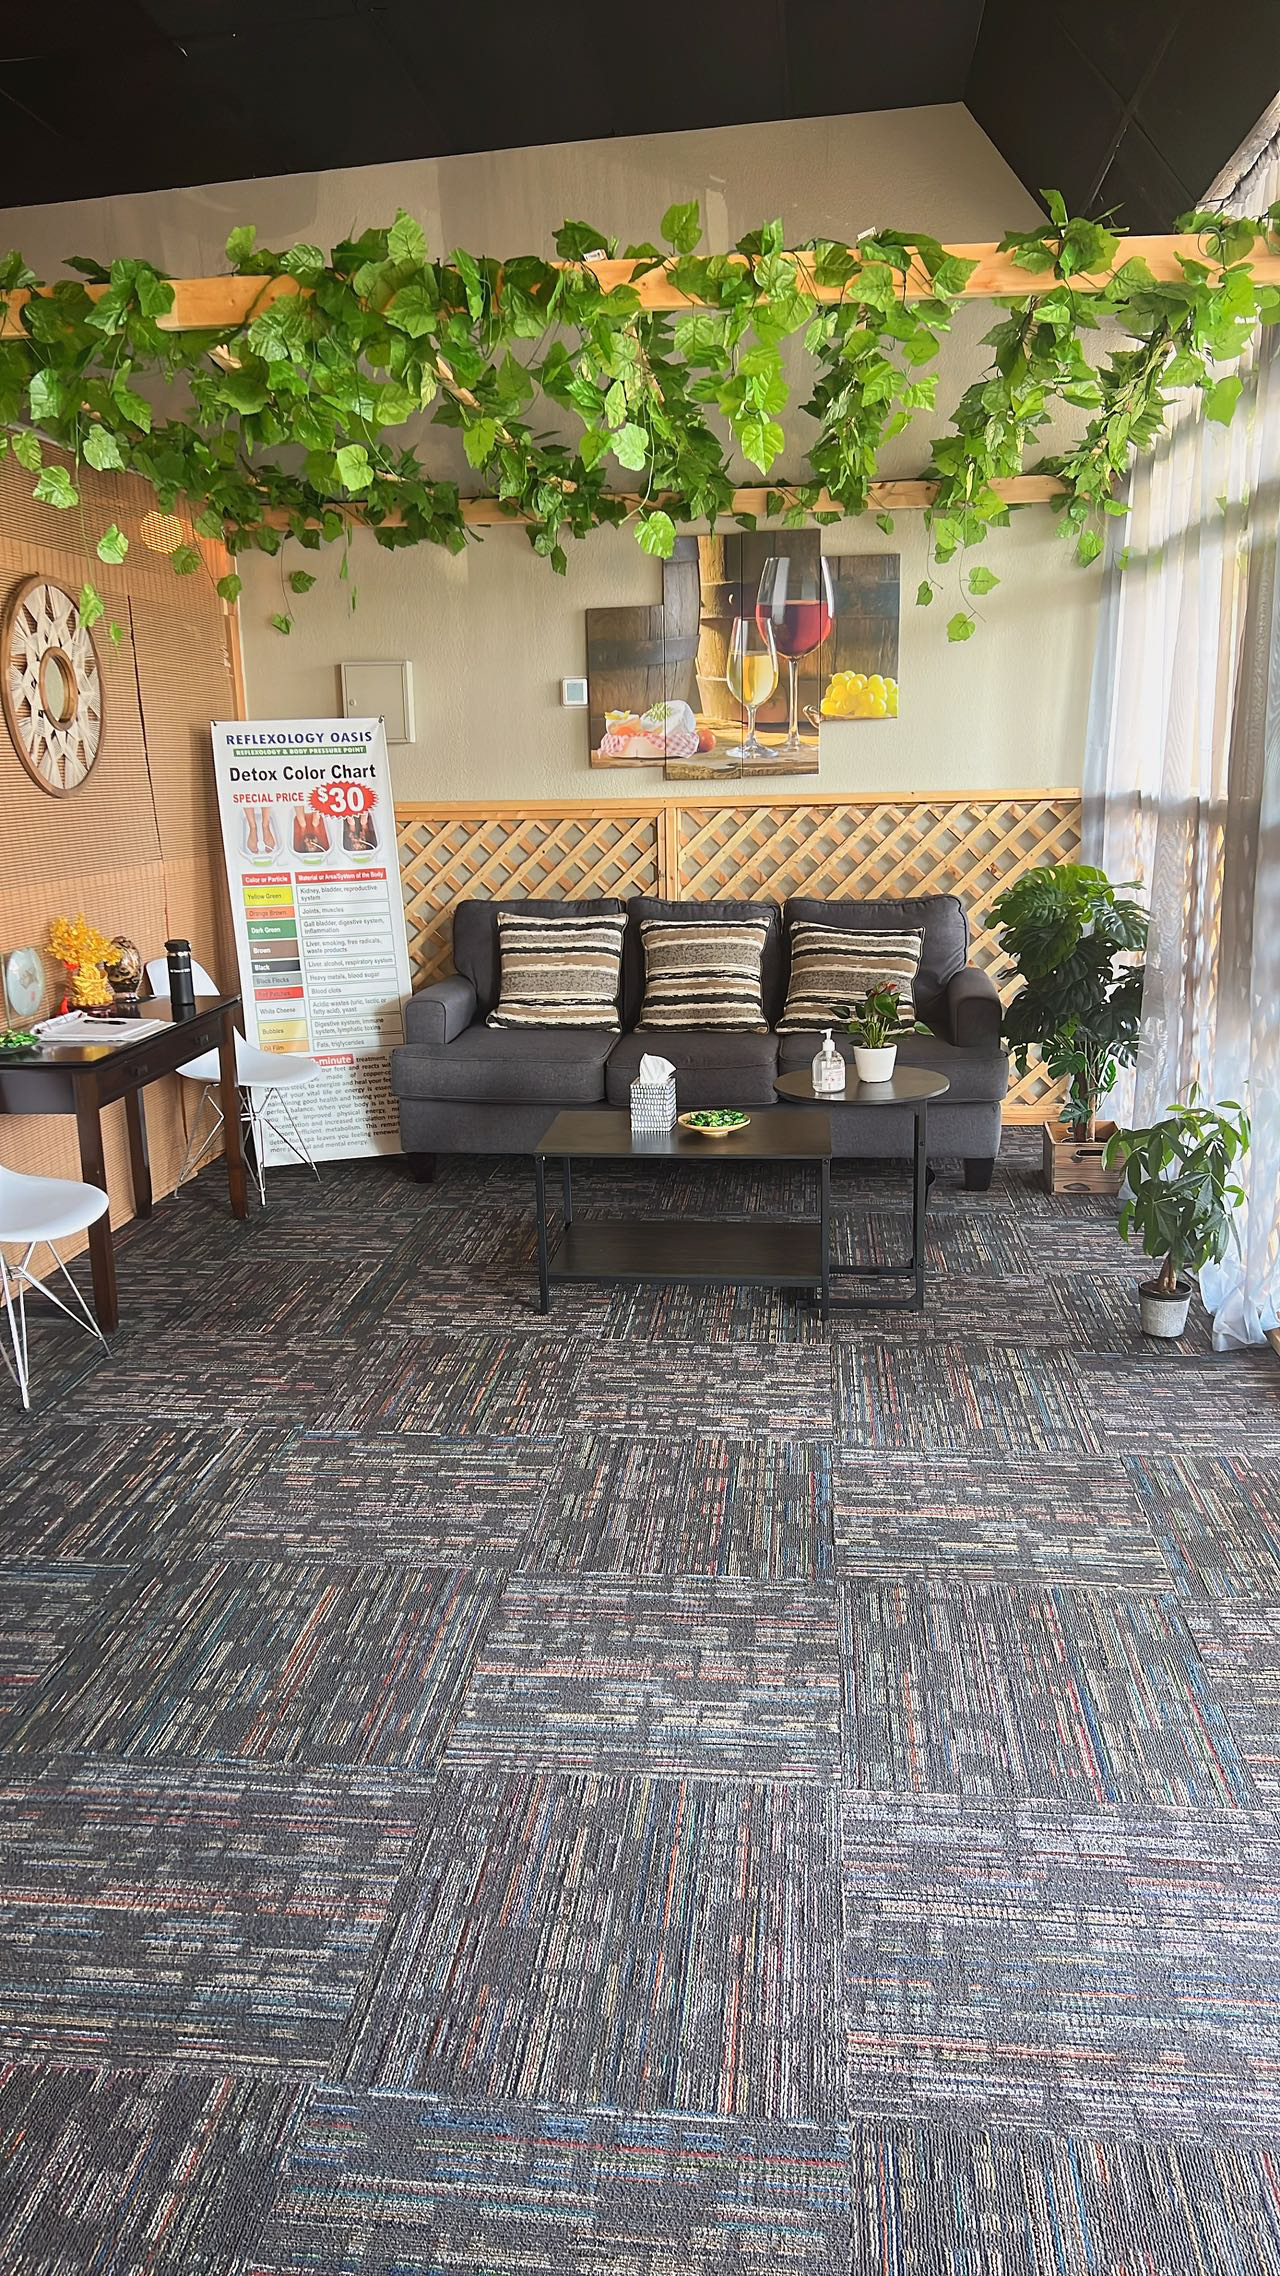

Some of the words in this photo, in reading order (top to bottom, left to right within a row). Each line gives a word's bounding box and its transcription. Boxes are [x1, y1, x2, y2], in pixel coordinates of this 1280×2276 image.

[226, 733, 325, 745] REFLEXOLOGY
[331, 732, 372, 742] OASIS
[230, 767, 278, 781] Detox
[283, 766, 325, 780] Color
[331, 764, 376, 778] Chart
[233, 793, 273, 803] SPECIAL
[276, 792, 304, 802] PRICE
[317, 786, 365, 812] $30
[260, 1007, 275, 1015] White
[313, 1008, 325, 1016] fatty
[342, 1006, 357, 1014] yeast
[315, 1020, 340, 1029] Digestive
[316, 1027, 337, 1035] system,
[337, 1025, 363, 1034] lymphatic
[331, 1039, 364, 1047] triglycerides
